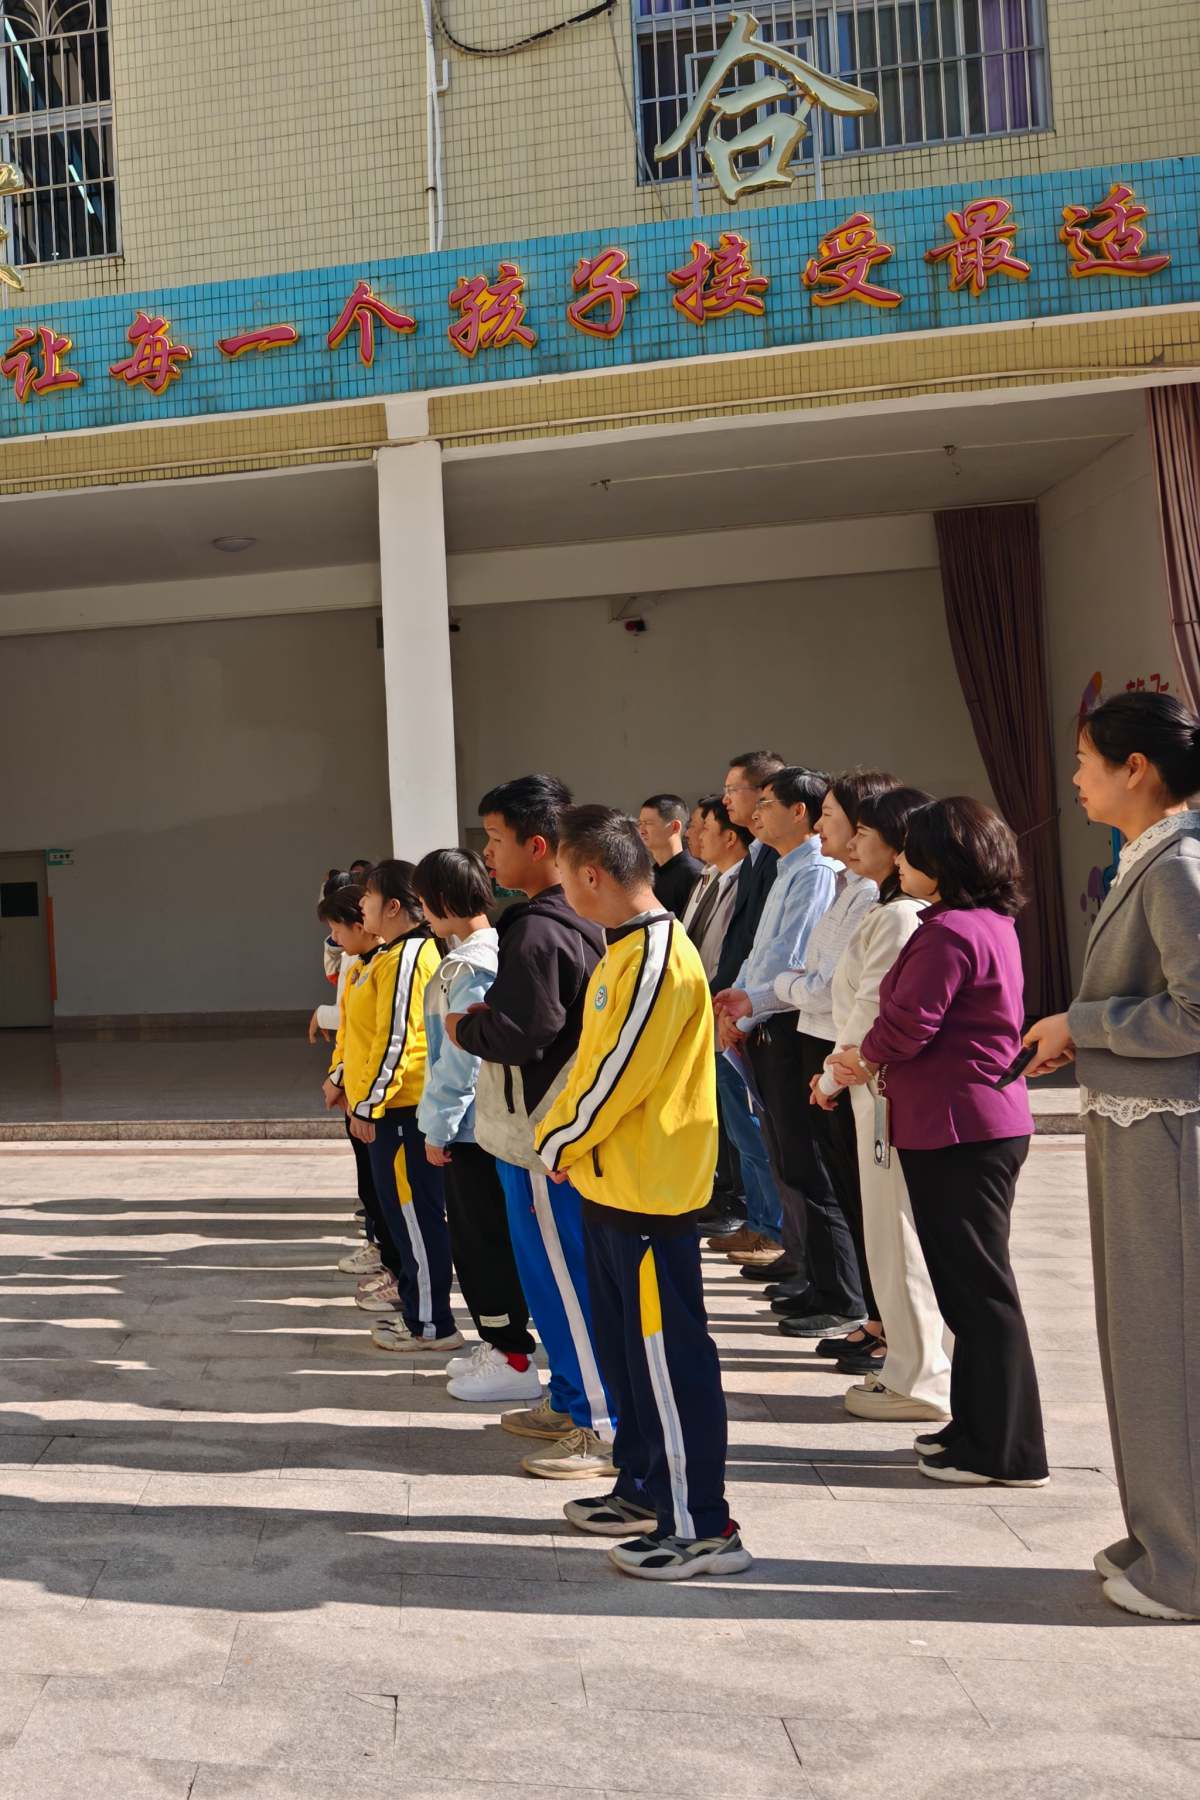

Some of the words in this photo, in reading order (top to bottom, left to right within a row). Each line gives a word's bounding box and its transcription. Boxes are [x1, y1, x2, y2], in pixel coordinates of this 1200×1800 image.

[0, 182, 1171, 403] 让每一个孩子接受最适
